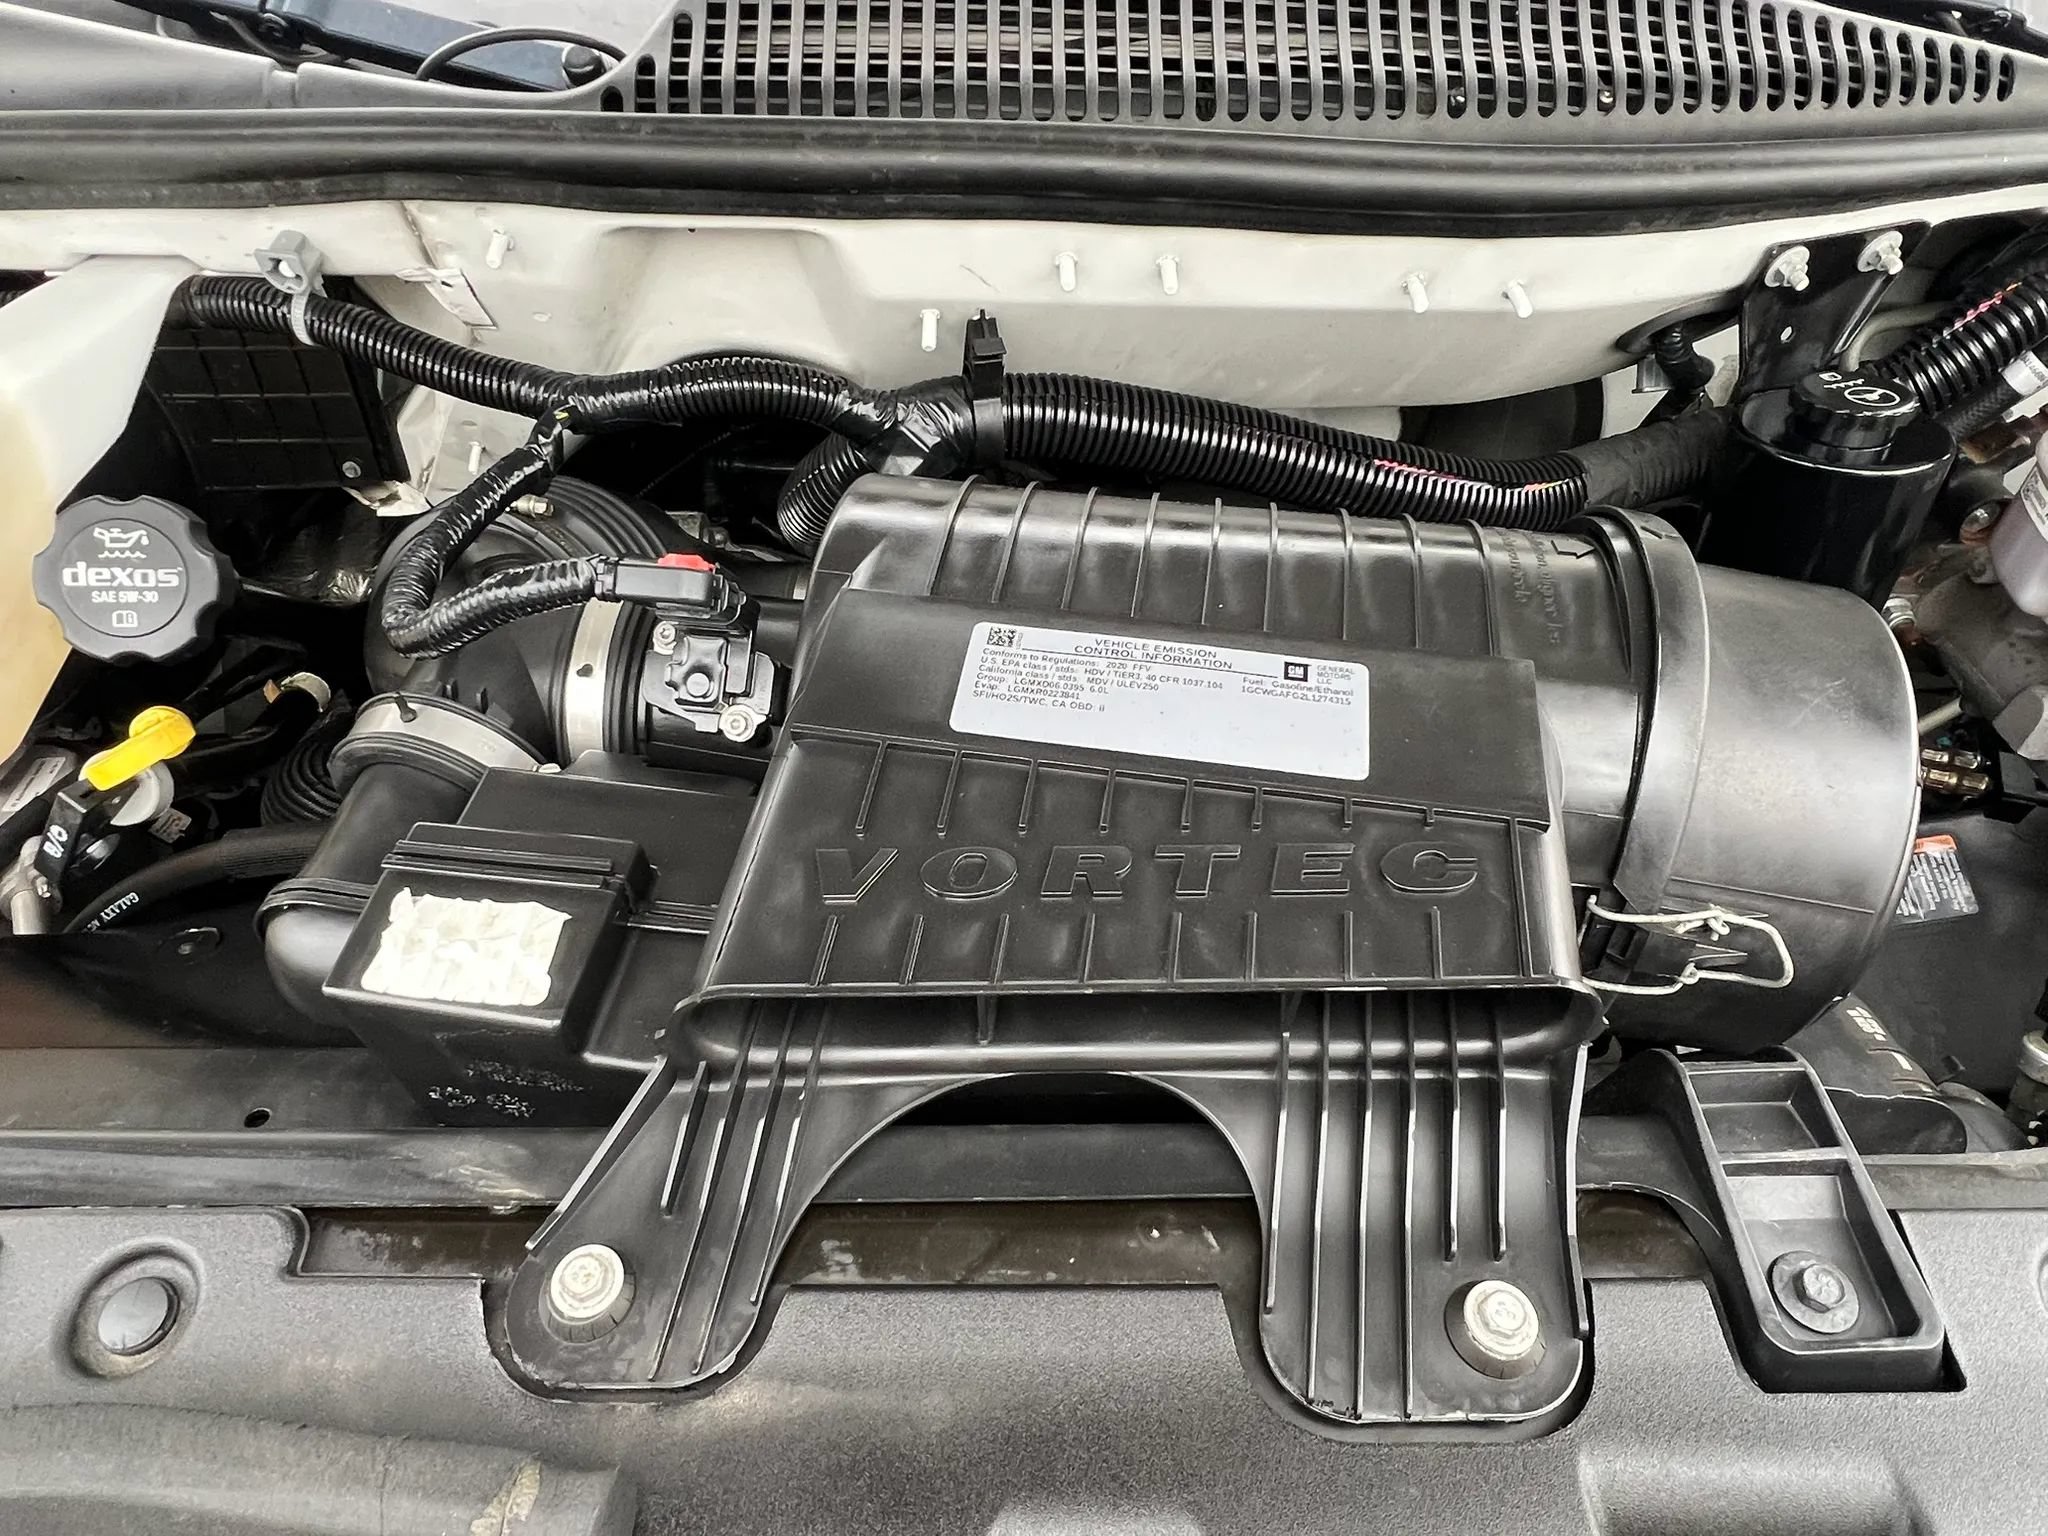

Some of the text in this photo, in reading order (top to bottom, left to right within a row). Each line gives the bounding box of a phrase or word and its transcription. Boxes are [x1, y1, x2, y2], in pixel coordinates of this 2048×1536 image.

[62, 561, 180, 587] dexos
[92, 591, 159, 603] SAE 5W-30
[1074, 646, 1232, 670] CONTROL INFORMATION
[1095, 638, 1217, 658] VEHICLE EMISSION
[982, 648, 1028, 660] Conforms
[1042, 654, 1100, 667] Regulations:
[1106, 661, 1128, 670] 2020
[1133, 664, 1152, 672] FFV
[1316, 664, 1356, 674] GENERAL
[978, 664, 1023, 676] California
[1025, 671, 1049, 680] class
[1086, 676, 1108, 686] MDV
[1116, 680, 1159, 691] ULEV250
[1002, 659, 1020, 668] EPA
[1022, 662, 1046, 671] class
[1084, 668, 1105, 676] HDV
[1146, 674, 1156, 682] 40
[1160, 675, 1180, 684] CFR
[1317, 671, 1352, 680] MOTORS
[1090, 685, 1109, 694] 6.0L
[1272, 680, 1354, 697] Gasoline/Ethanol
[1052, 700, 1066, 708] CA
[816, 840, 1479, 904] VORTEC
[100, 891, 140, 923] GALAXY
